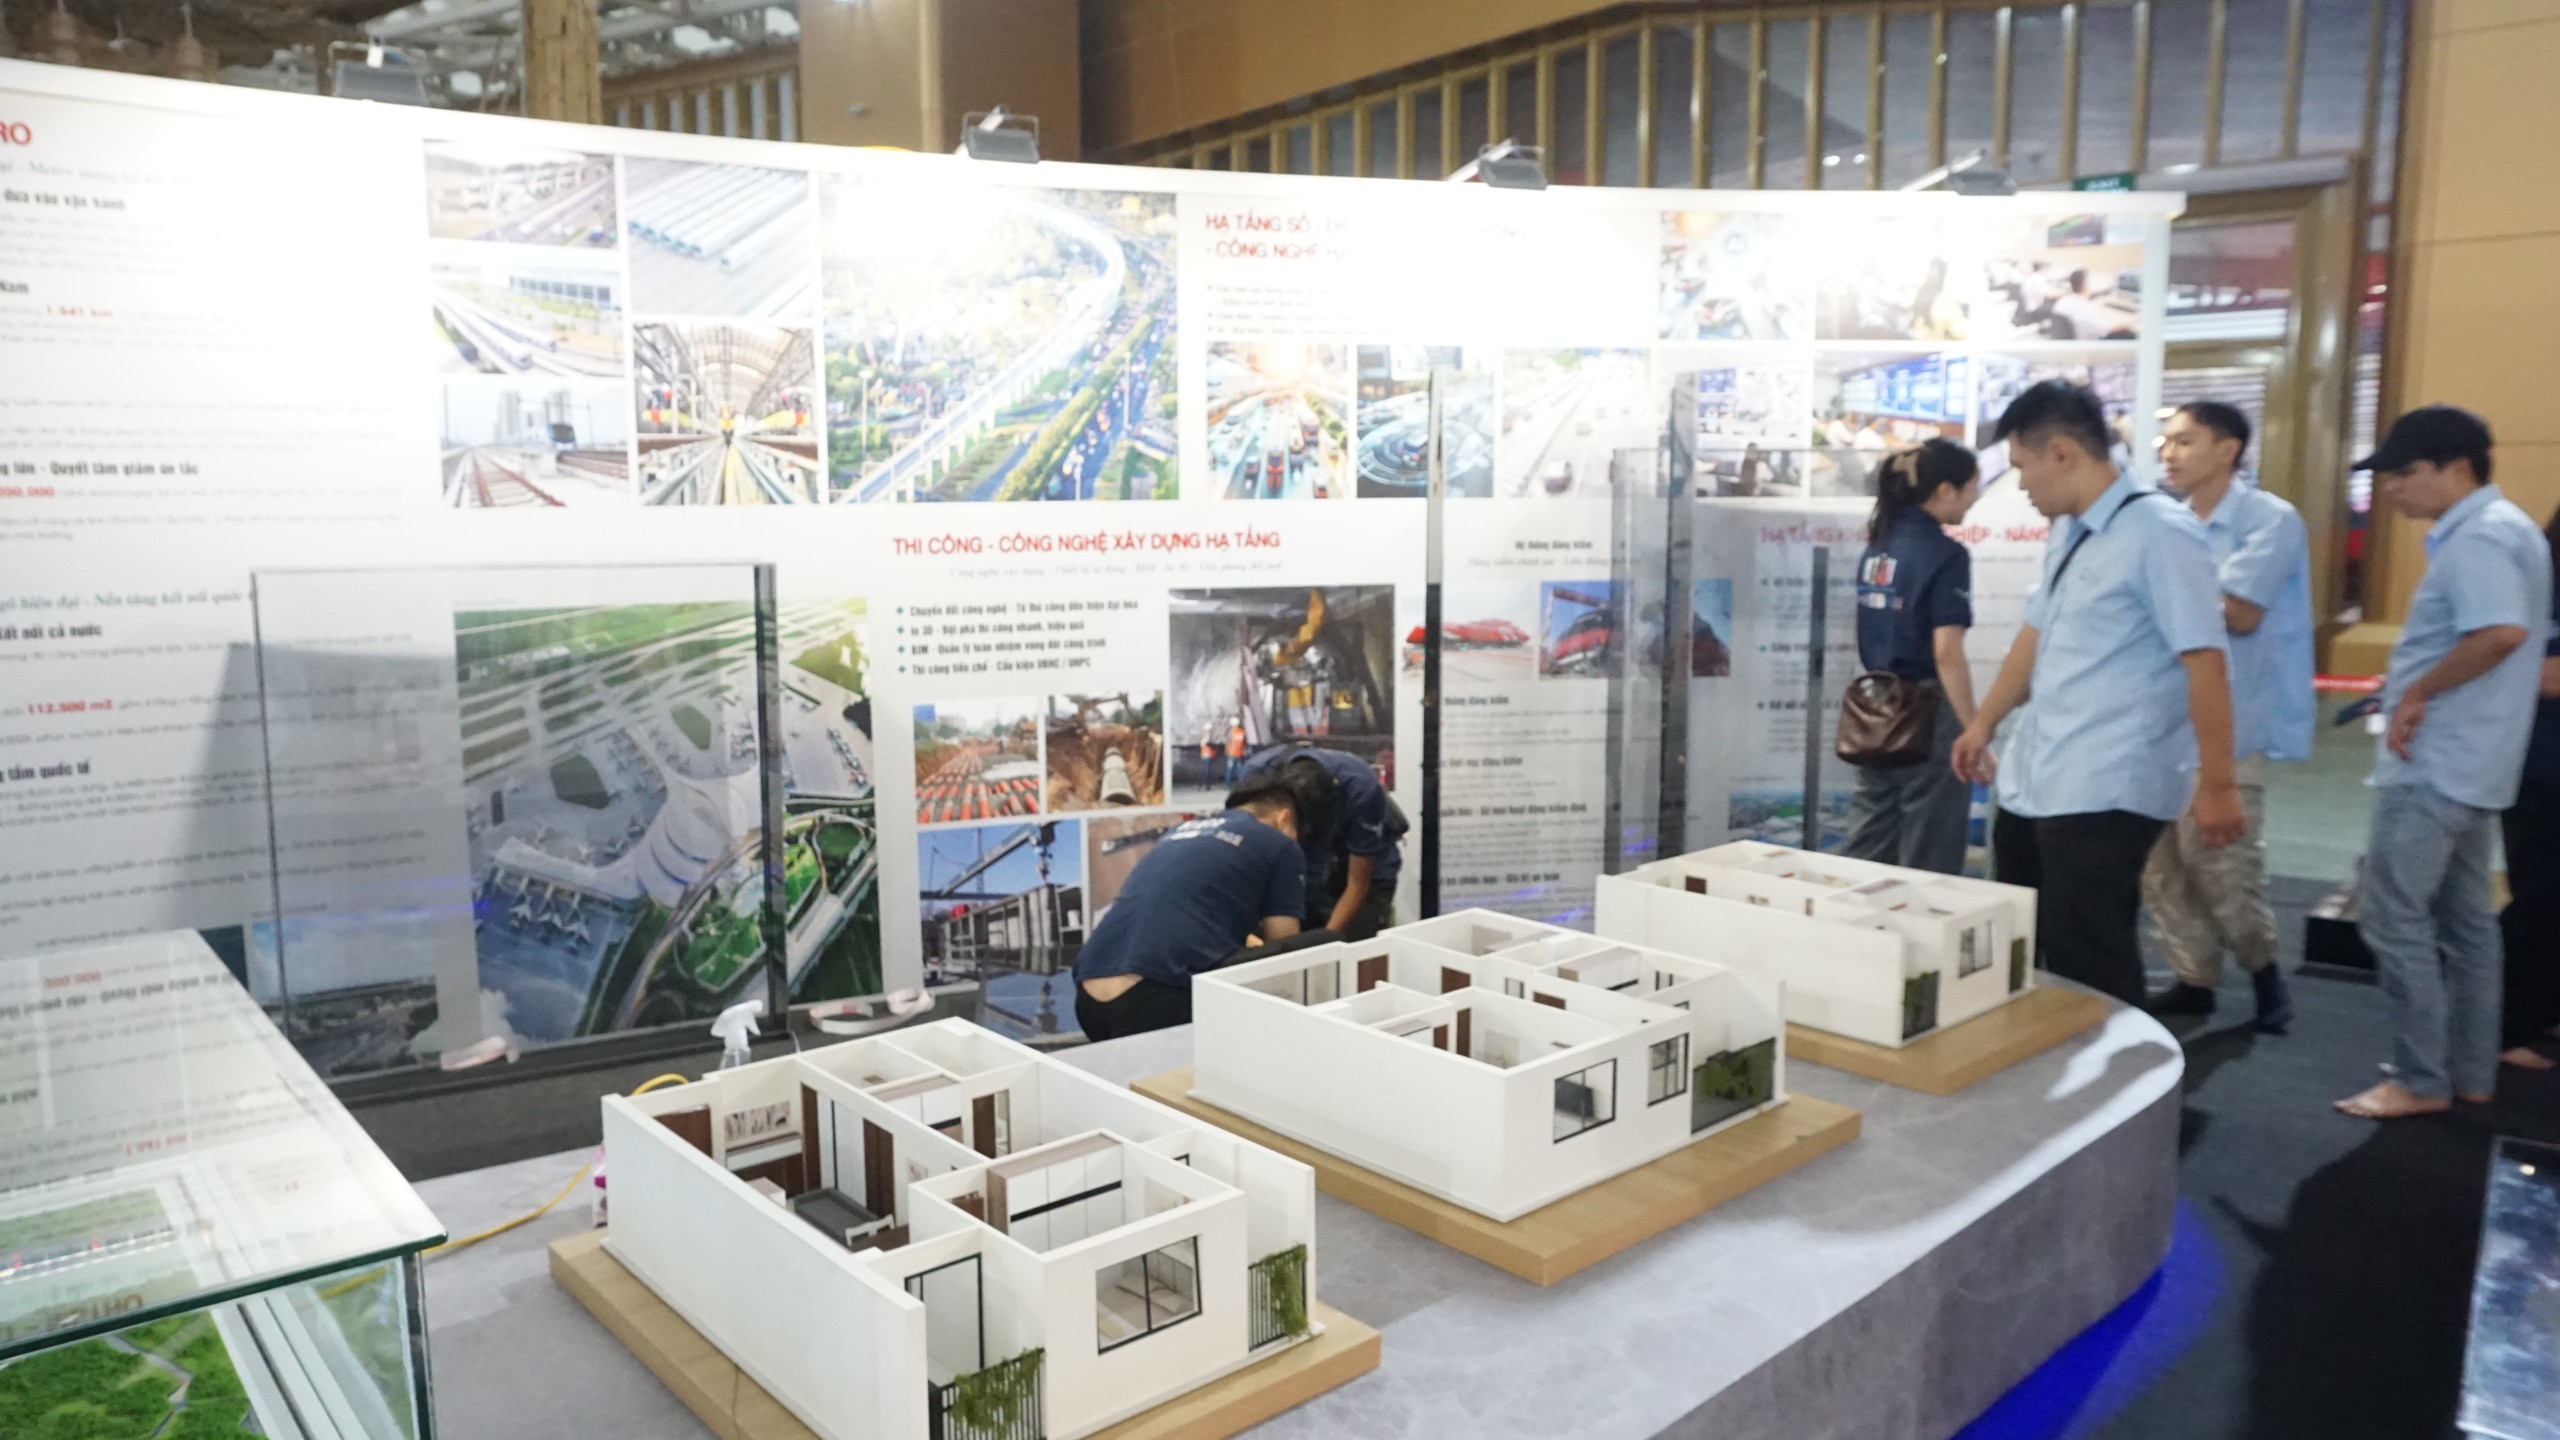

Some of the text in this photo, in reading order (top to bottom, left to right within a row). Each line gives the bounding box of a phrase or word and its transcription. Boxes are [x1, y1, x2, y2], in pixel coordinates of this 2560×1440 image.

[1216, 238, 1268, 260] CÔNG
[893, 537, 923, 556] THI
[928, 531, 983, 555] CÔNG
[999, 531, 1053, 555] CÔNG
[1058, 530, 1108, 555] NGHỆ
[1113, 529, 1146, 552] XÂY
[1151, 531, 1201, 555] DỰNG
[1206, 531, 1230, 553] HẠ
[1235, 524, 1281, 549] TẦNG
